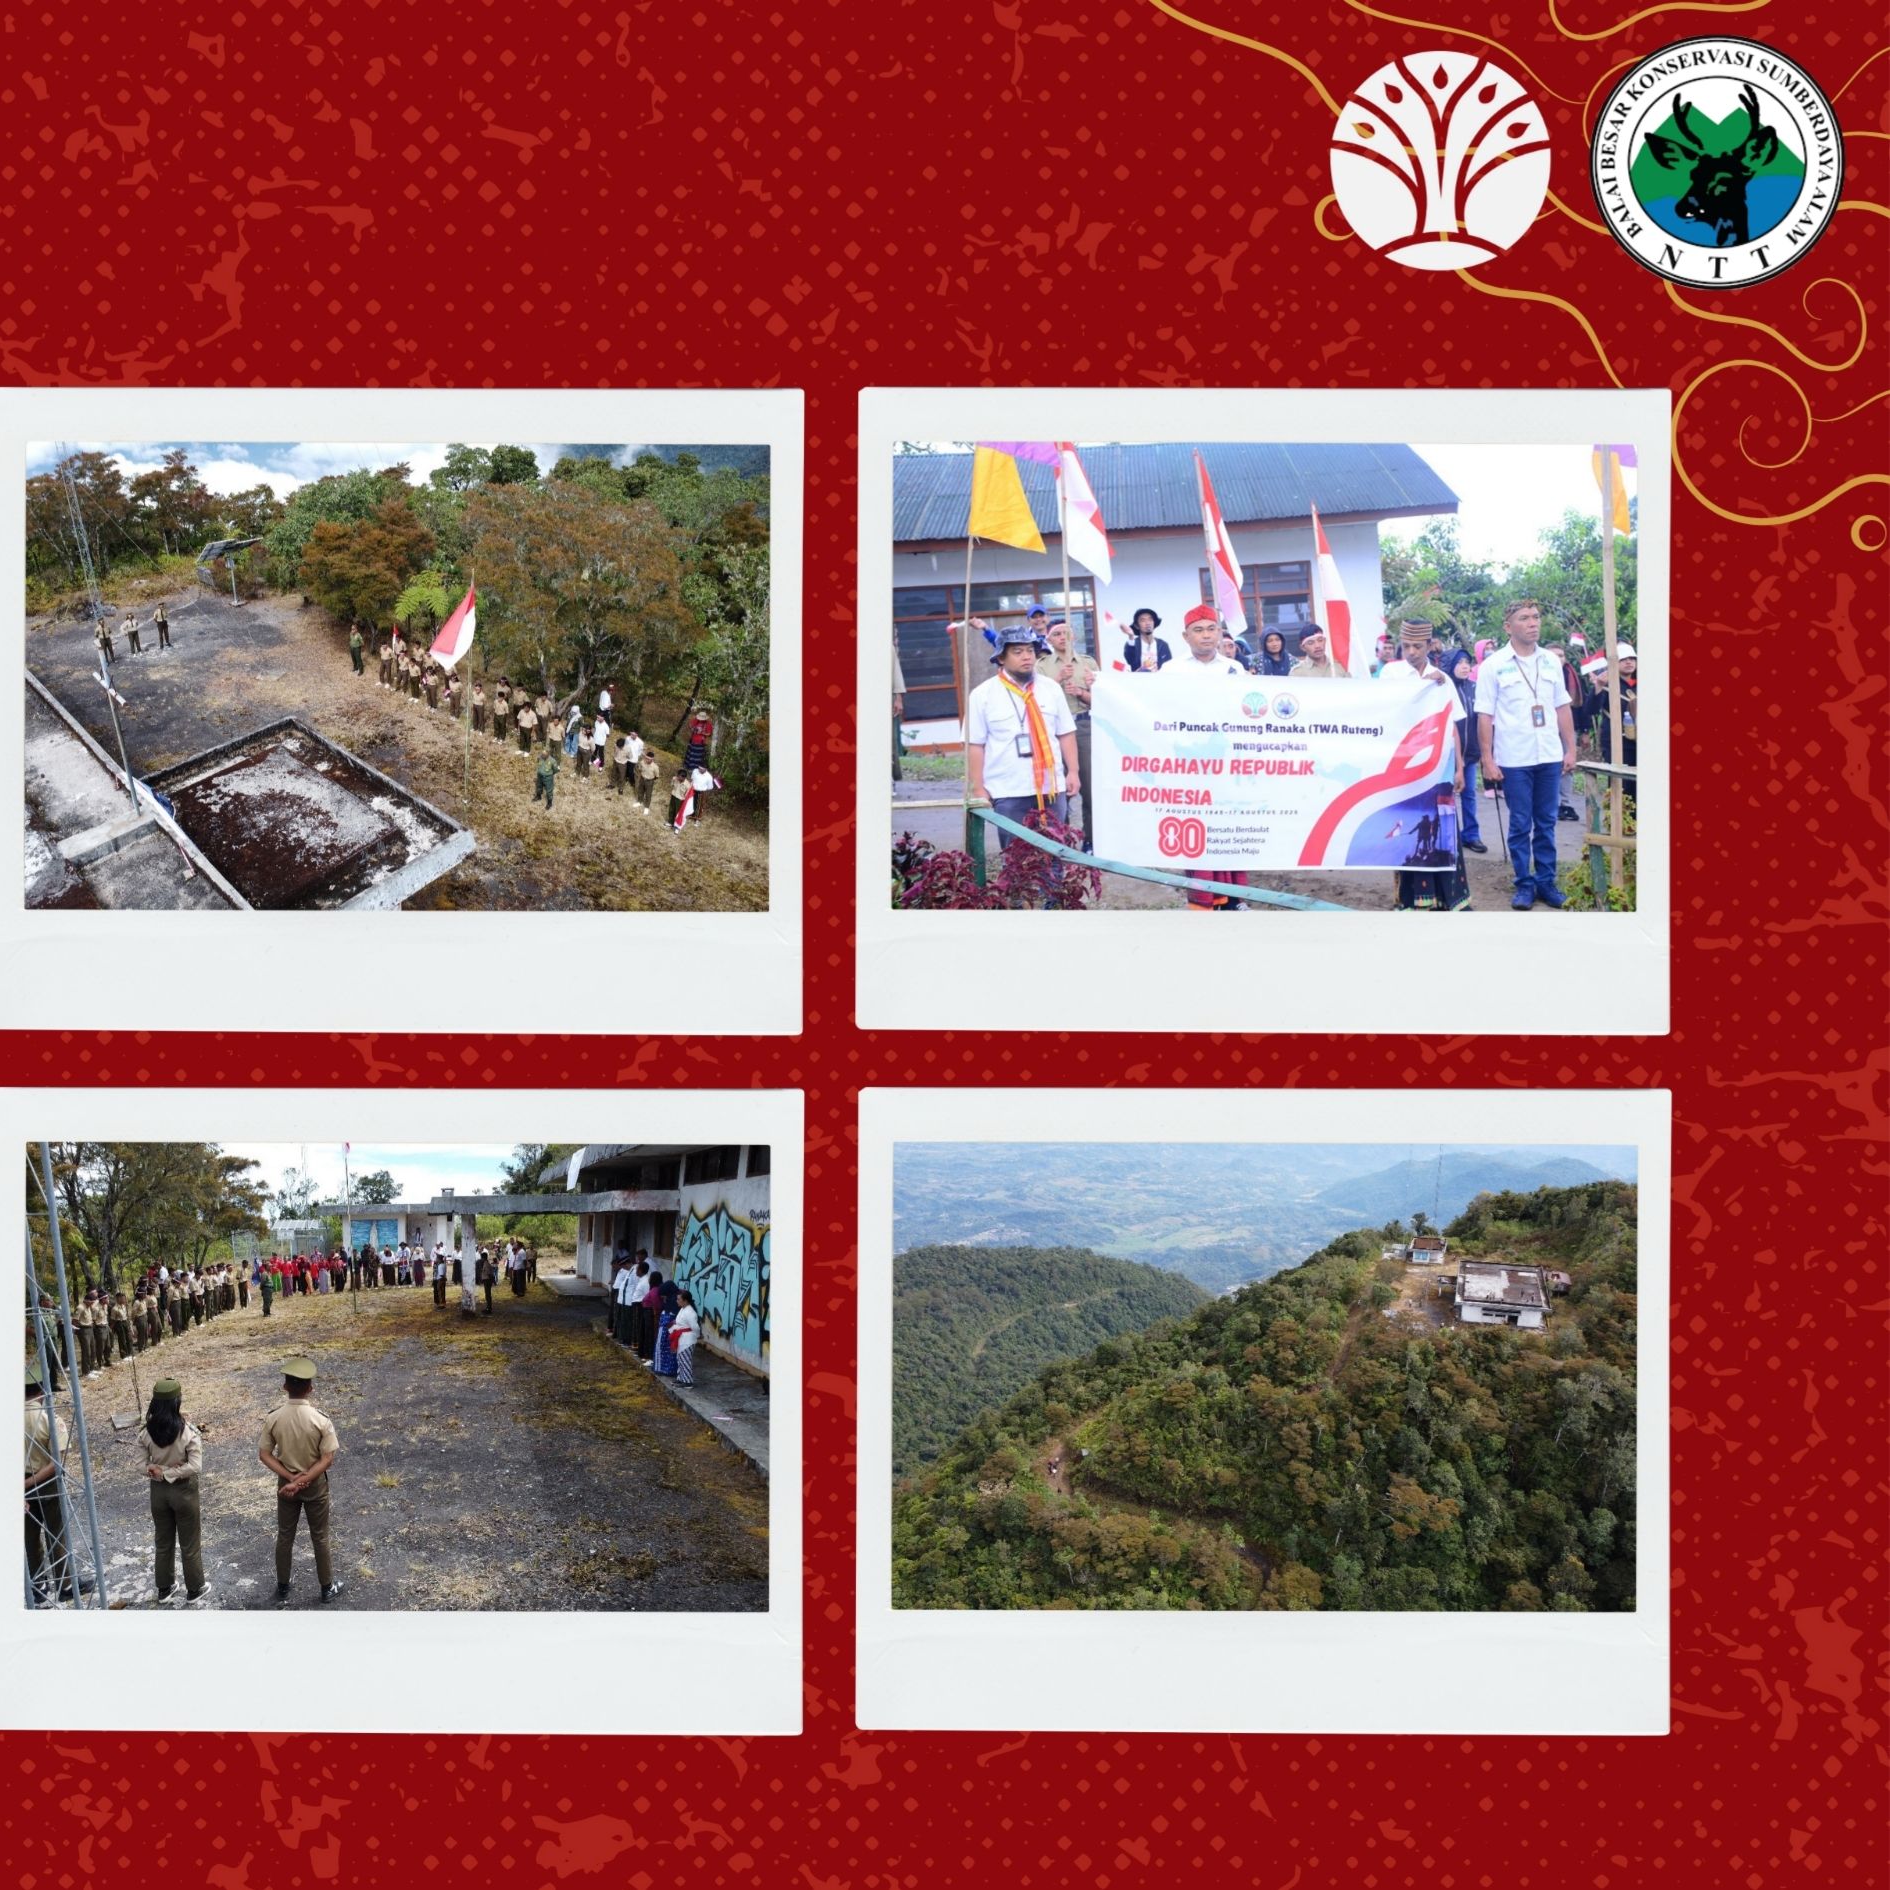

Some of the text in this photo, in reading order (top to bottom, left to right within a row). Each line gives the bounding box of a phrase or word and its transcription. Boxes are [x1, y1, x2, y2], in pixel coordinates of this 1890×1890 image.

[1153, 721, 1384, 737] Dari Puncak Gunung Ranaka (TWA Ruteng)
[1233, 741, 1308, 752] mengucapkan
[1121, 756, 1315, 776] DIRGAHAYU REPUBLIK
[1121, 786, 1213, 806] INDONESIA
[1206, 825, 1270, 834] Bersatu Berdaulat
[1158, 816, 1206, 859] 80
[1206, 836, 1266, 845] Rakyat Sejahtera
[1206, 848, 1260, 856] Indonesia Maju
